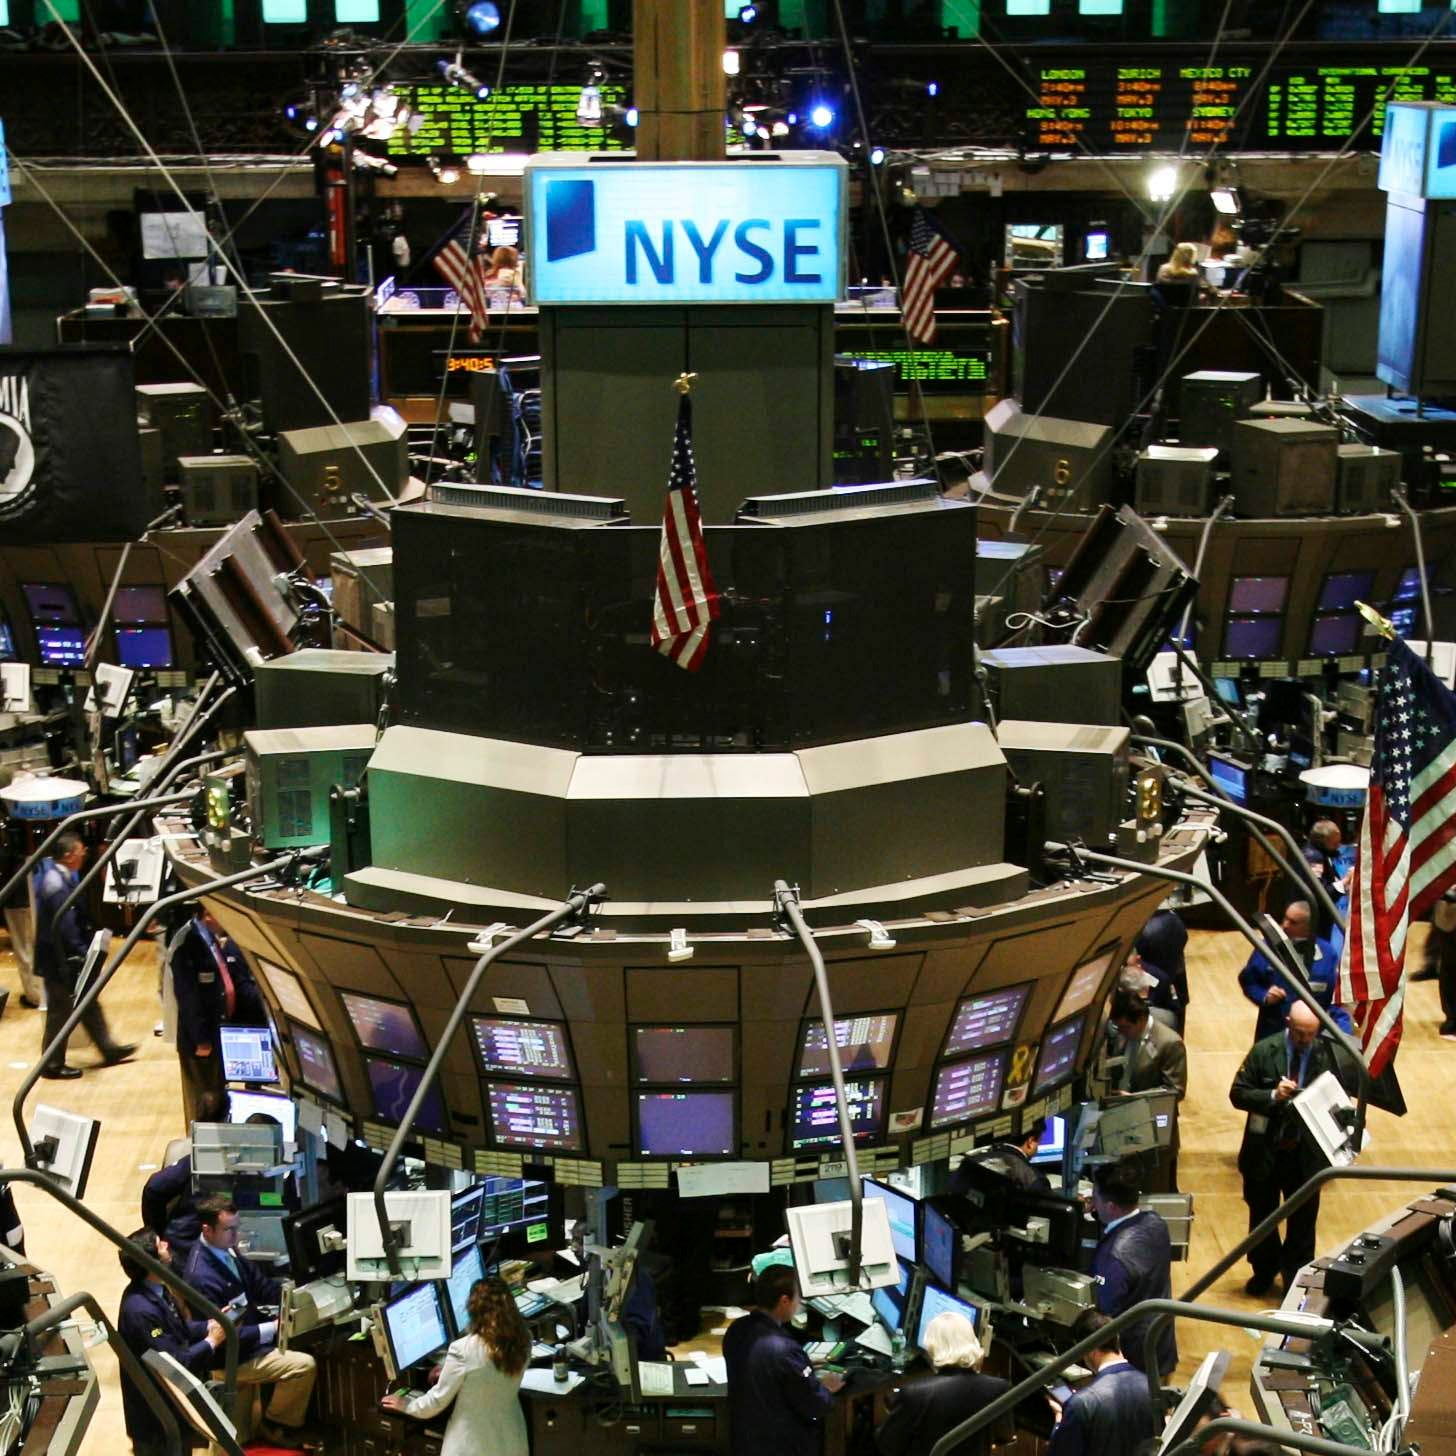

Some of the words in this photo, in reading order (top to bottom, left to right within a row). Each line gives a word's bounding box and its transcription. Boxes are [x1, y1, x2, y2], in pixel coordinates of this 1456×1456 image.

[625, 219, 823, 285] NYSE
[324, 465, 340, 491] 5
[1055, 458, 1071, 485] 6
